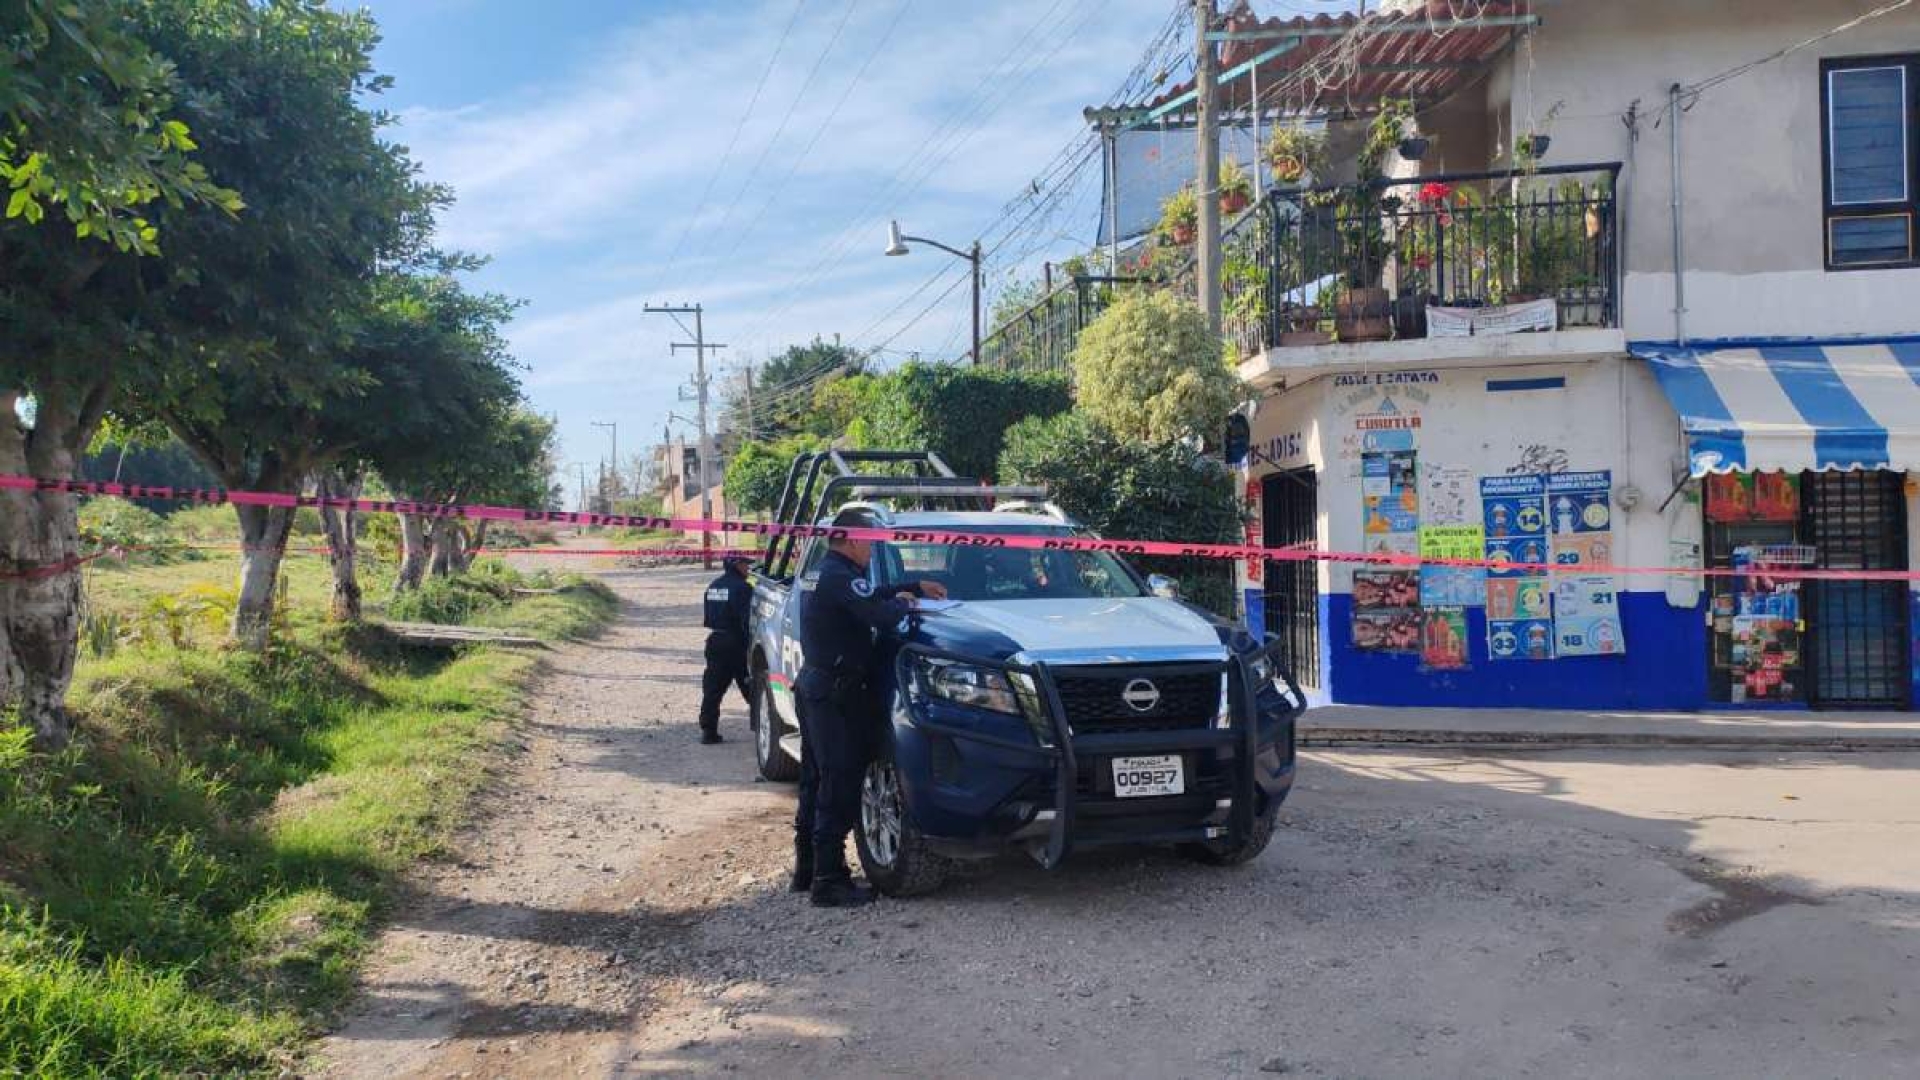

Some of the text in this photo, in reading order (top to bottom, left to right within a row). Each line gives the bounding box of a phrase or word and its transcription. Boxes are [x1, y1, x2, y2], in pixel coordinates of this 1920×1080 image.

[893, 531, 1005, 547] PELIGRO
[1557, 553, 1580, 564] 29
[1117, 769, 1177, 787] 00927
